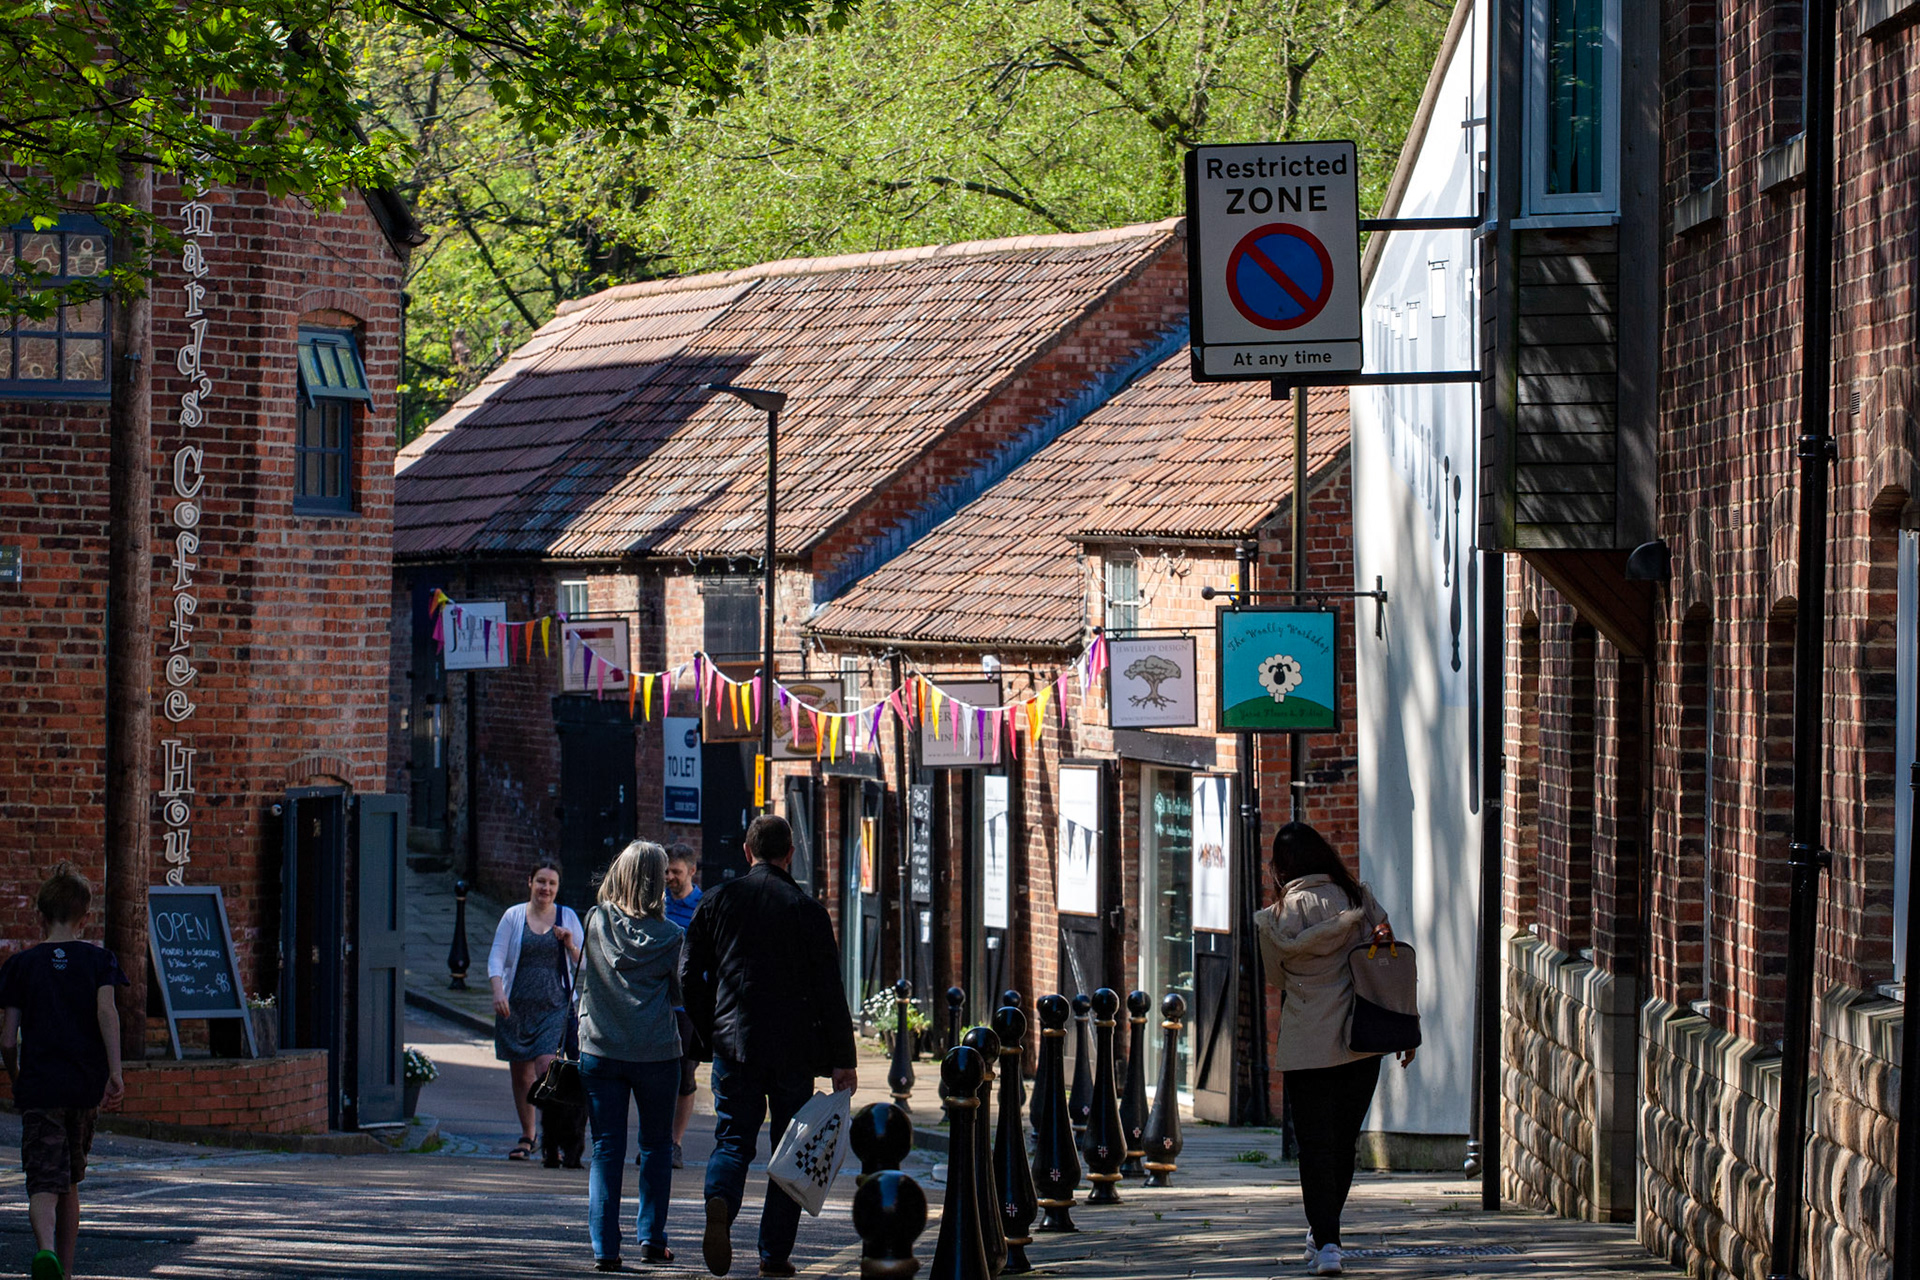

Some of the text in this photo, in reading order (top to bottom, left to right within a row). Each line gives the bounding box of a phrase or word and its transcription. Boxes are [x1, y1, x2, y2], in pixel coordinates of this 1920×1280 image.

[1206, 153, 1347, 179] Restricted
[1226, 185, 1327, 215] ZONE
[1233, 350, 1332, 367] At any time
[159, 84, 218, 887] Lnard's Coffee Hous
[1115, 644, 1188, 654] JEWELLERY DESIGN
[1228, 622, 1330, 655] The Woolly Workshop
[668, 755, 695, 778] TO LET
[156, 912, 210, 942] OPEN
